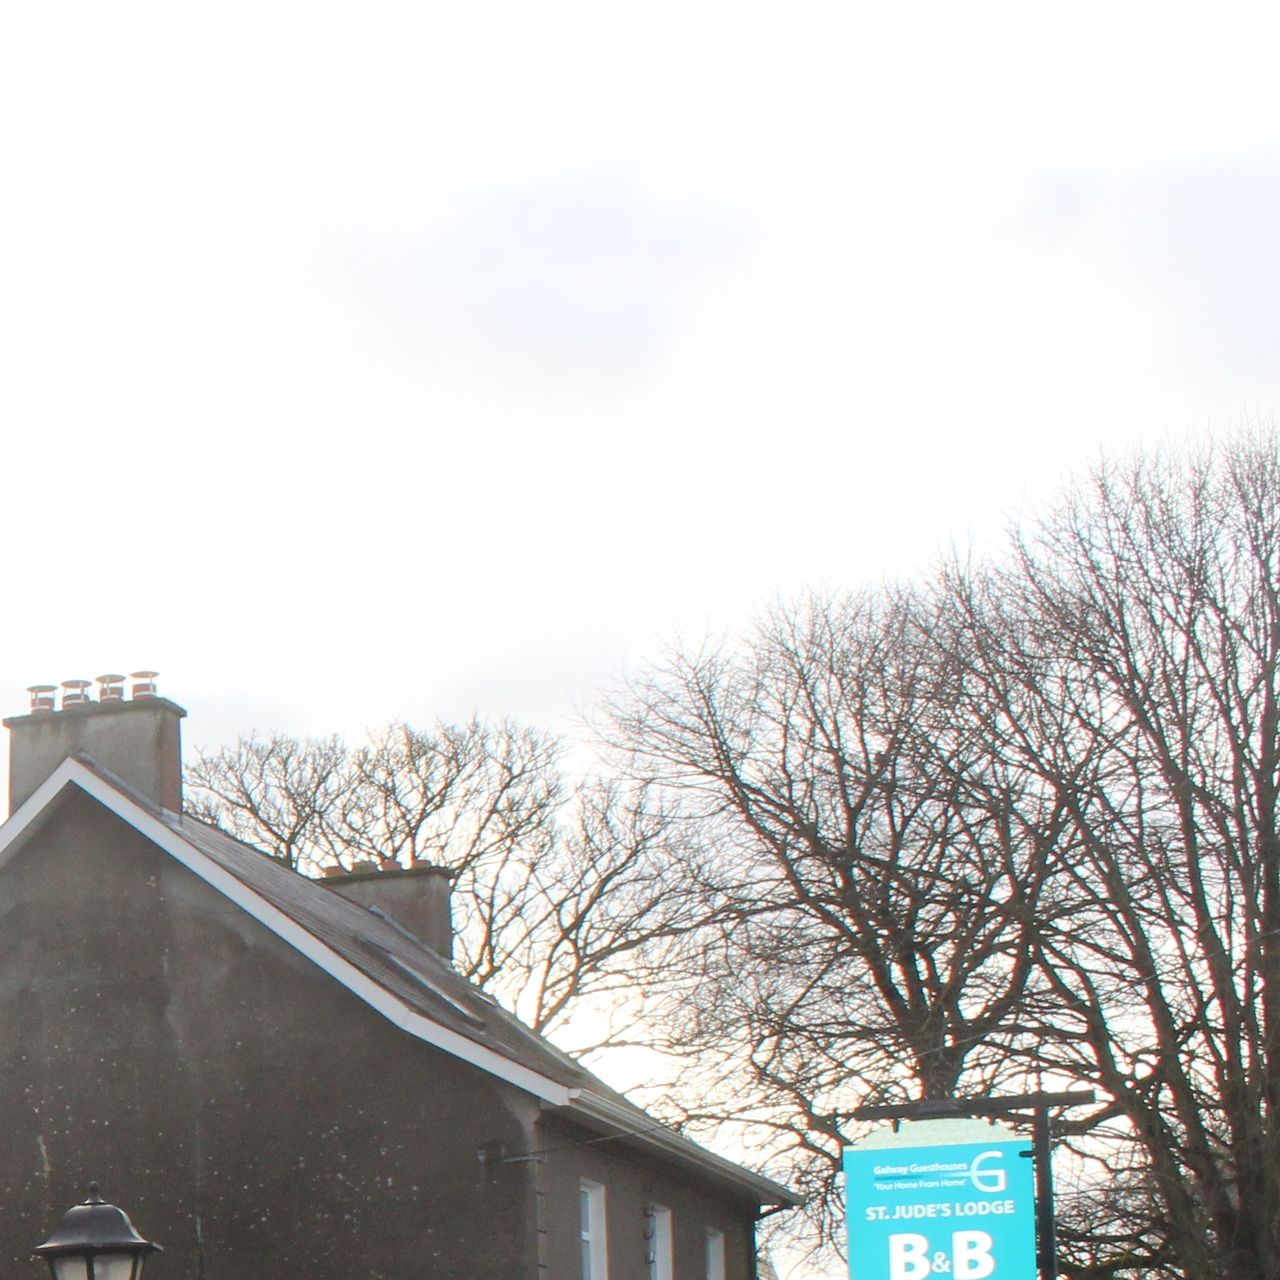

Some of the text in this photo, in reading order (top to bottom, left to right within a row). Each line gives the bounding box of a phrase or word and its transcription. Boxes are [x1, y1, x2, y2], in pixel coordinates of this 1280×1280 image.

[873, 1163, 968, 1175] Galway Guesthouses
[894, 1181, 918, 1190] Home
[920, 1180, 939, 1188] From
[865, 1200, 1015, 1221] ST. JUDE'S LODGE
